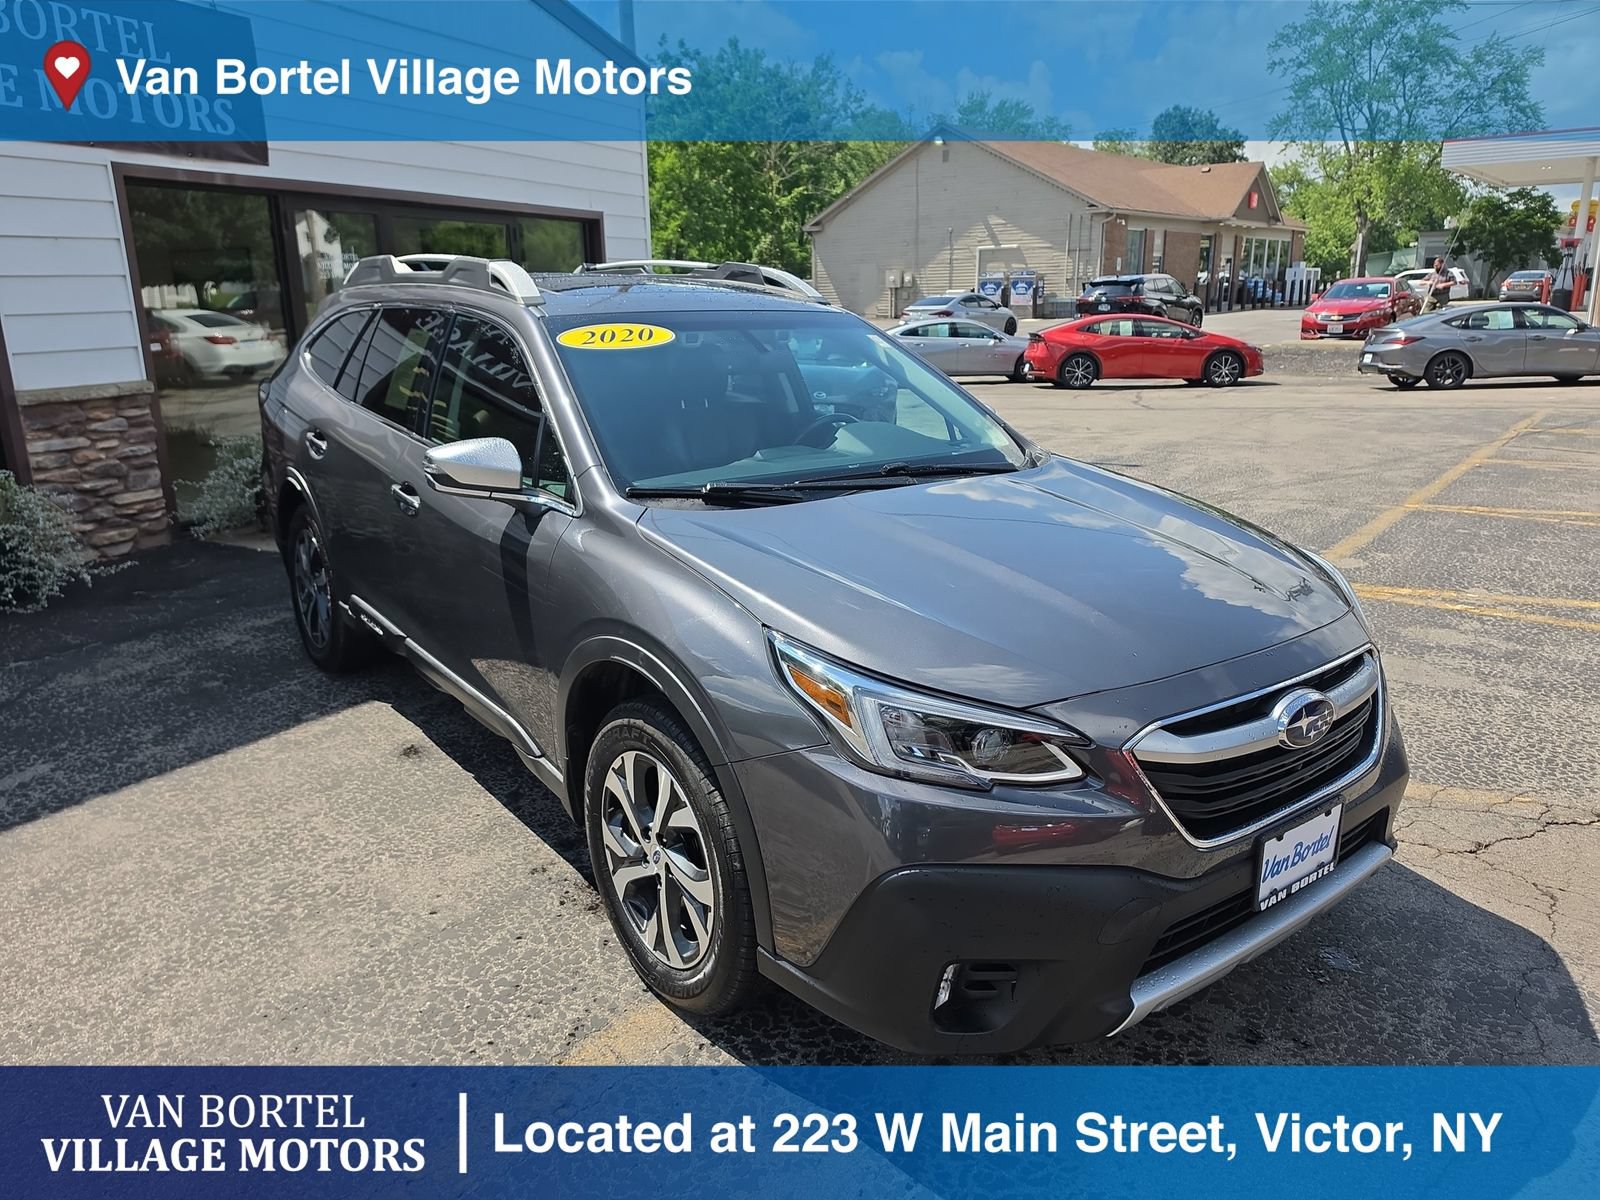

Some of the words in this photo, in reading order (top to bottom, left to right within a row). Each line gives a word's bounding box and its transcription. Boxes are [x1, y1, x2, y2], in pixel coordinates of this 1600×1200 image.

[582, 327, 654, 345] 2020
[1261, 854, 1291, 884] Van
[1290, 824, 1335, 869] Bortel
[1260, 888, 1288, 911] VAN
[1291, 861, 1335, 894] BORTEL
